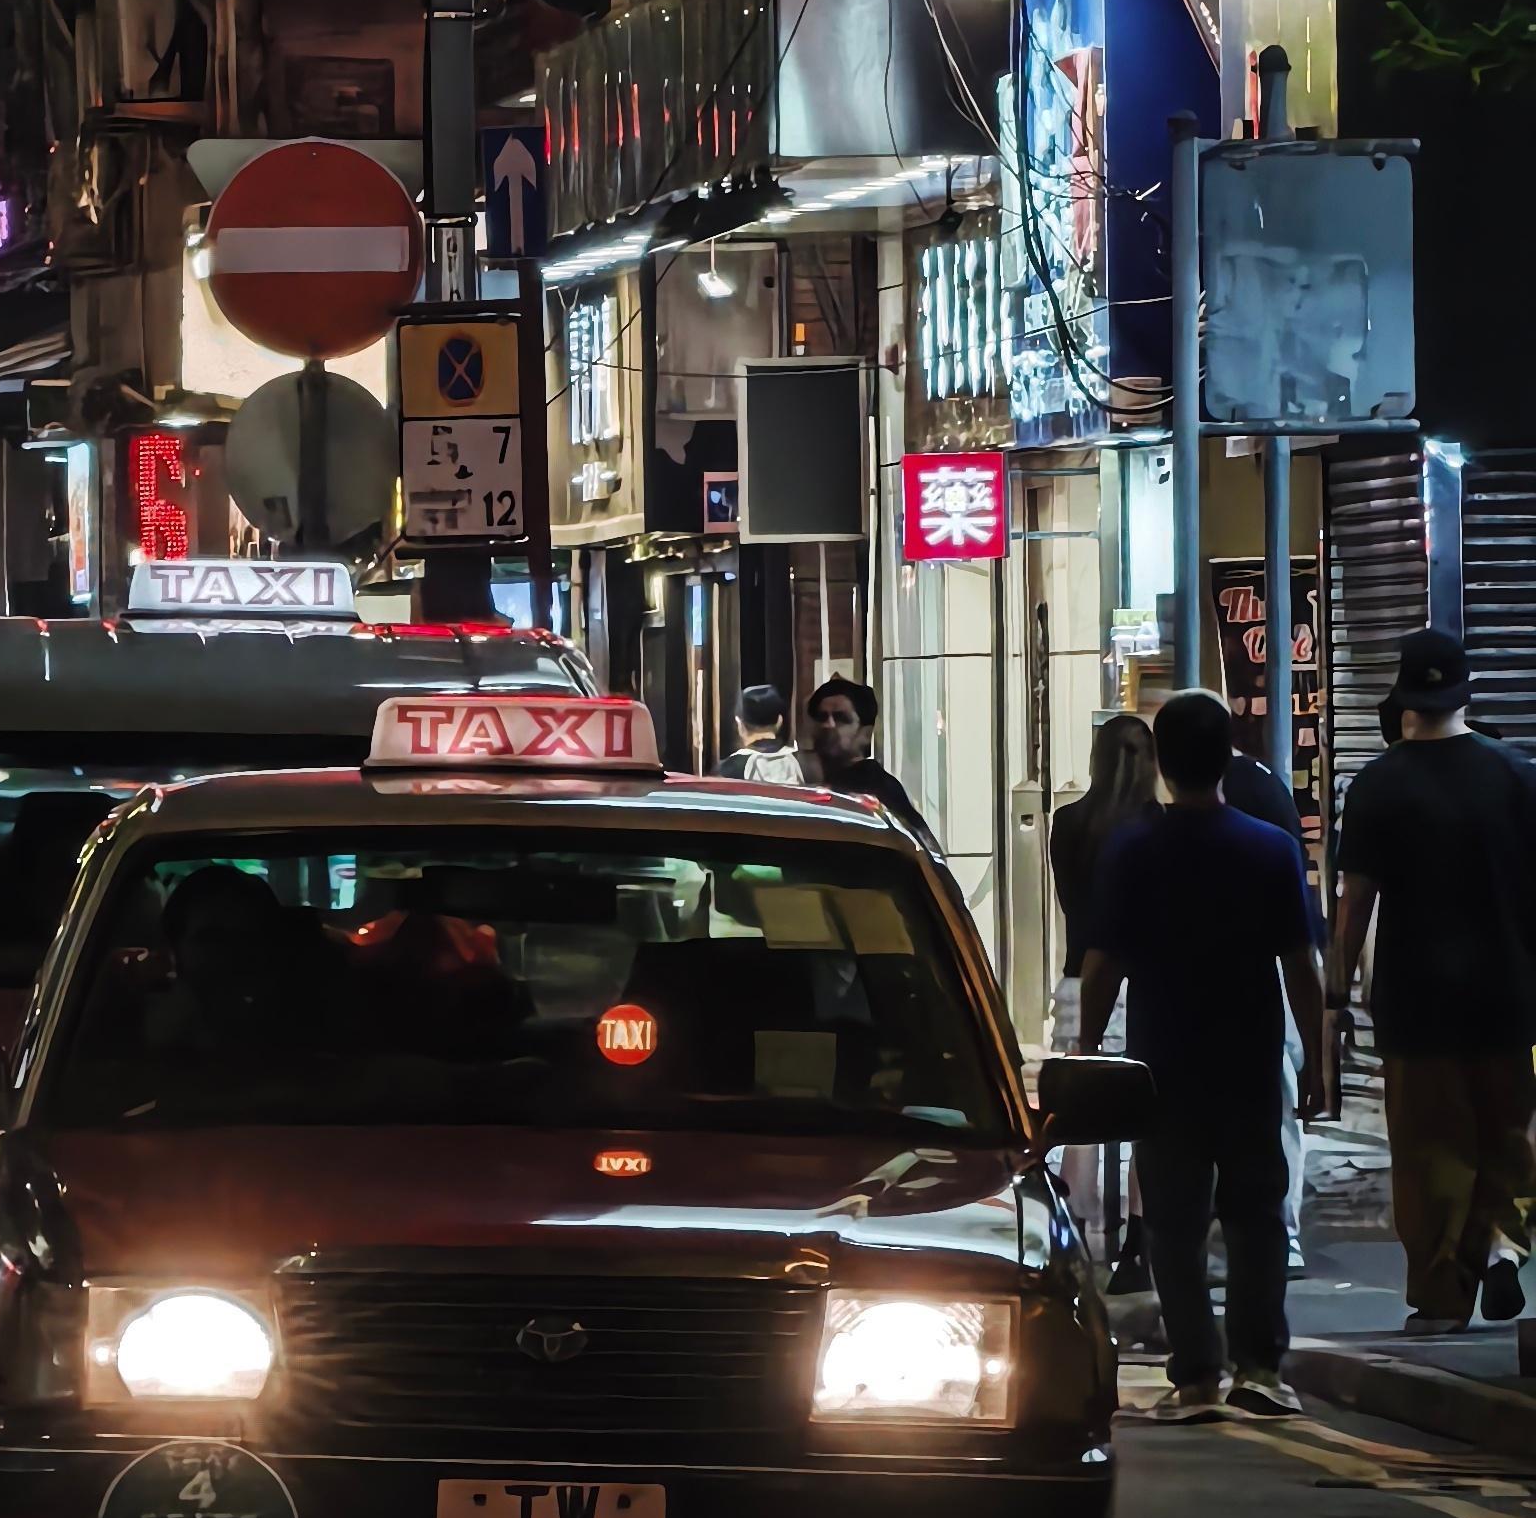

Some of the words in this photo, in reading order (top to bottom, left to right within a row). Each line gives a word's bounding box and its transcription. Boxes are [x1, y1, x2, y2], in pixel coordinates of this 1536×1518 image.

[492, 426, 511, 464] 7
[482, 490, 517, 527] 12
[919, 467, 996, 546] 藥
[150, 564, 336, 607] TAXI
[397, 703, 633, 759] TAXI
[600, 1020, 652, 1051] TAXI
[178, 1469, 217, 1509] 4
